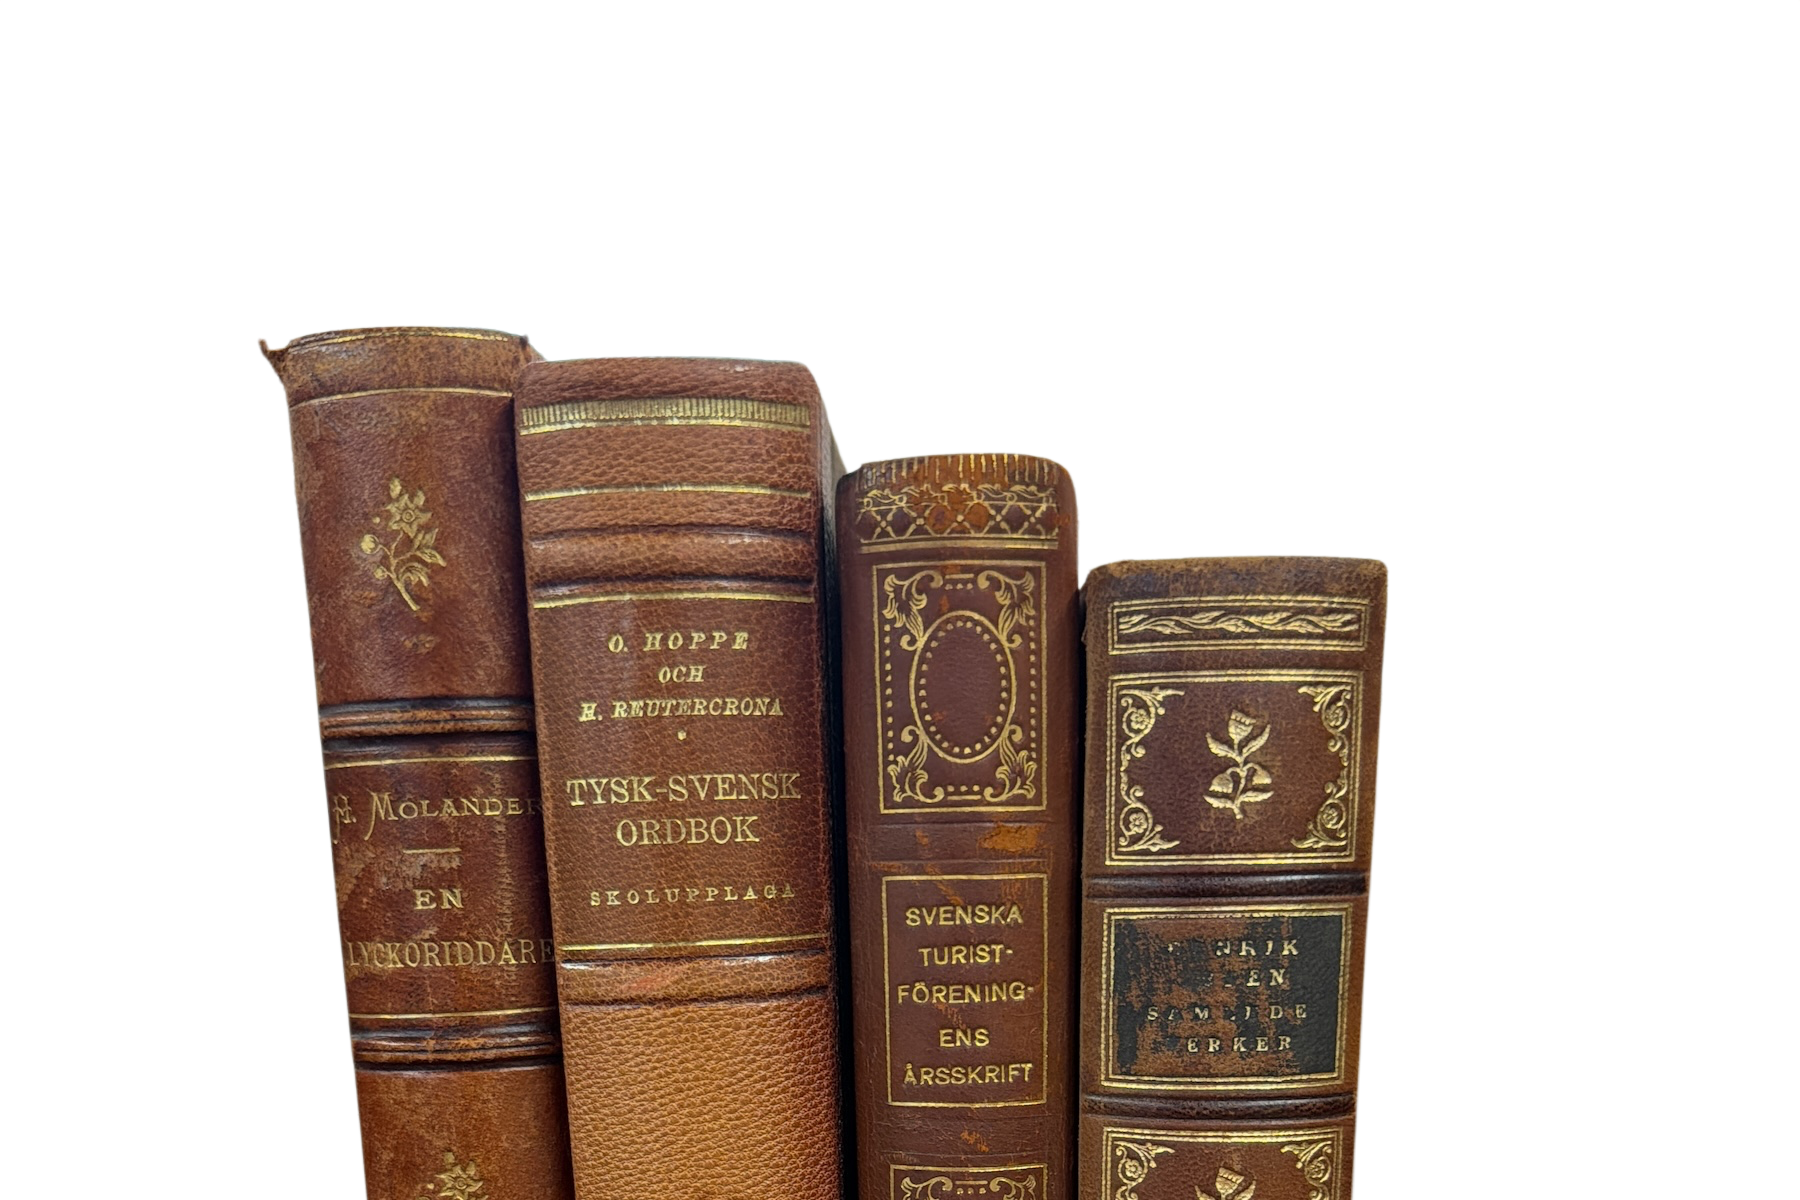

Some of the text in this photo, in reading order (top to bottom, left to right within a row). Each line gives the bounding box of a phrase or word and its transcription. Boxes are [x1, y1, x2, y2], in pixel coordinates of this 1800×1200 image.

[608, 632, 749, 653] O. HOPPE
[658, 666, 706, 683] OCH
[579, 698, 784, 722] H. REUTERCRONA
[566, 773, 801, 806] TYSK-SVENSK
[616, 816, 760, 847] ORDBOK
[413, 888, 465, 910] EN
[590, 883, 796, 907] SKOLUPPLAGA
[905, 904, 1024, 927] SVENSKA
[919, 944, 1014, 967] TURIST-
[897, 981, 1035, 1004] FÖRENING-
[939, 1028, 990, 1047] ENS
[904, 1063, 1034, 1086] ÅRSSKRIFT
